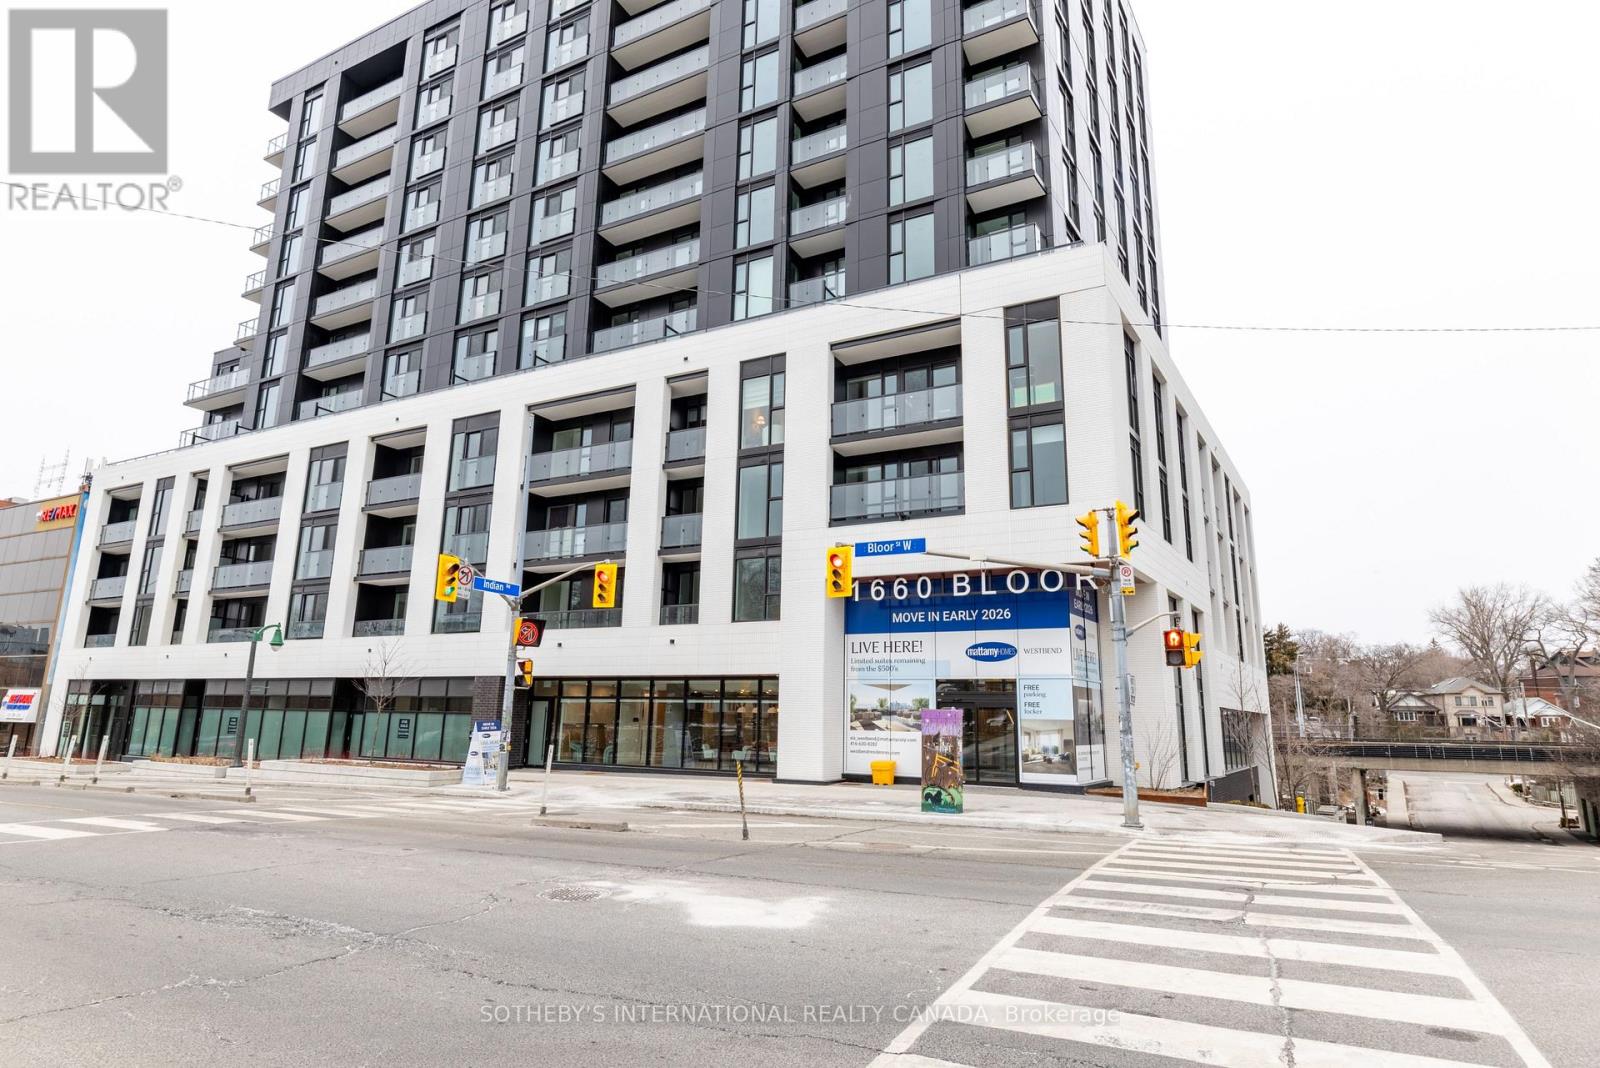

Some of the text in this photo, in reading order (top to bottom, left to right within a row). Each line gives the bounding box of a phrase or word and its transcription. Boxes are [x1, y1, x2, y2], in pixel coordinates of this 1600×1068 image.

[867, 543, 895, 553] Bloor
[903, 540, 911, 551] W
[483, 579, 504, 591] Indian
[852, 576, 932, 602] 1660
[953, 569, 1099, 597] BLOOR
[892, 608, 1012, 623] MOVE IN EARLY 2026
[851, 640, 923, 654] LIVE HERE!
